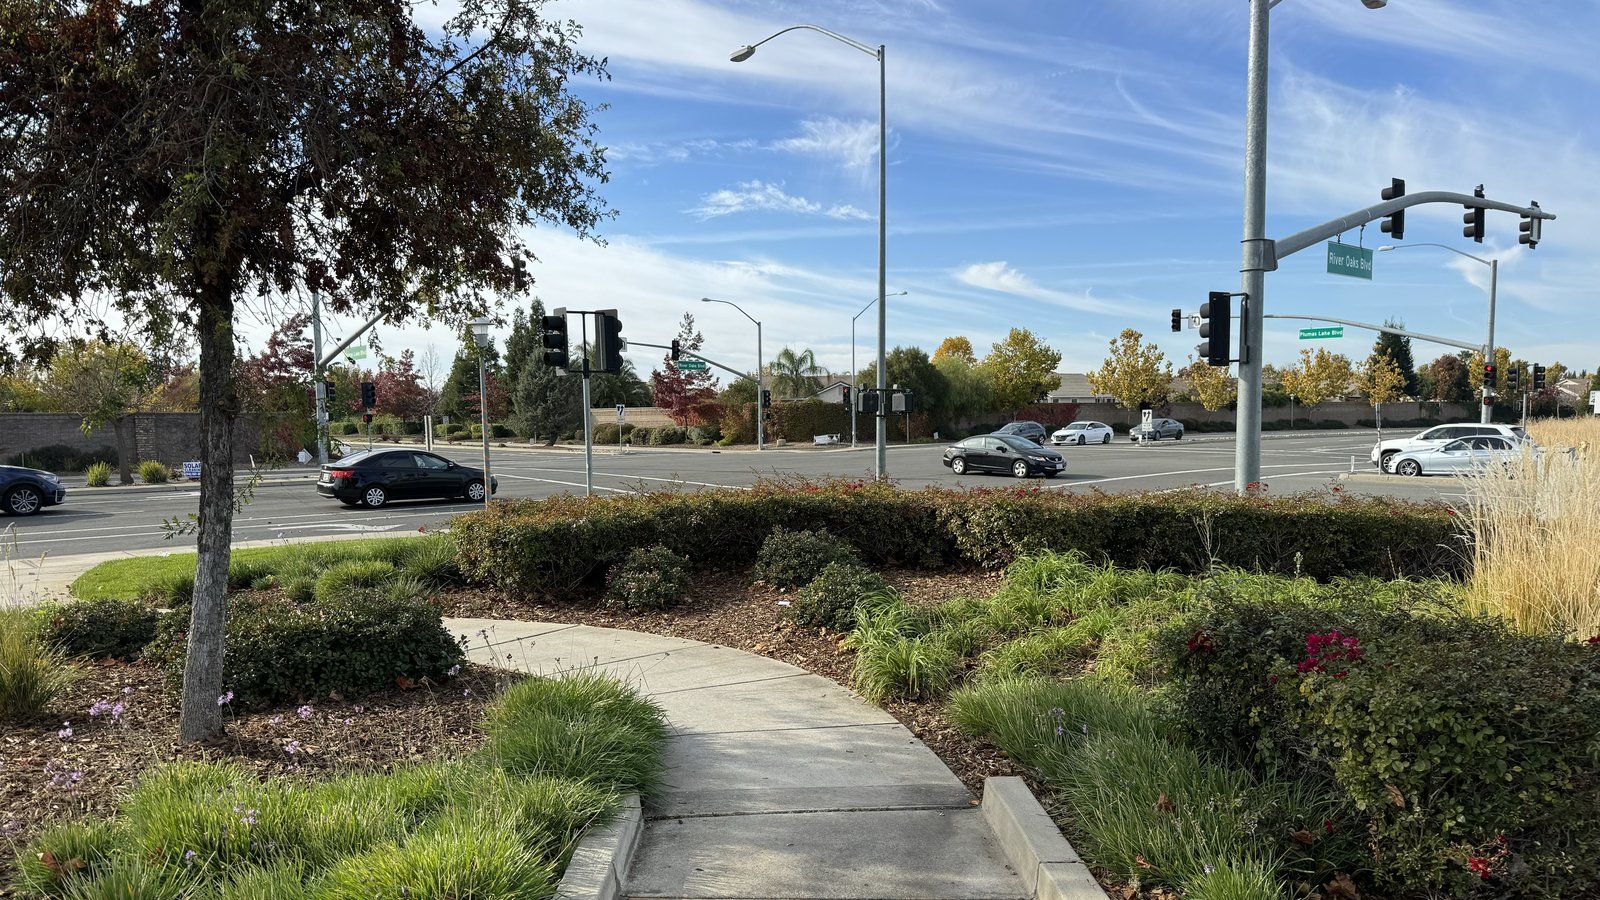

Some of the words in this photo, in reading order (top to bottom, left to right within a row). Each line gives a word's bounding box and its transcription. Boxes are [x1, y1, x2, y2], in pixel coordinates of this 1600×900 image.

[1329, 252, 1344, 266] River
[1345, 255, 1359, 269] Oaks
[1360, 257, 1371, 271] Blvd
